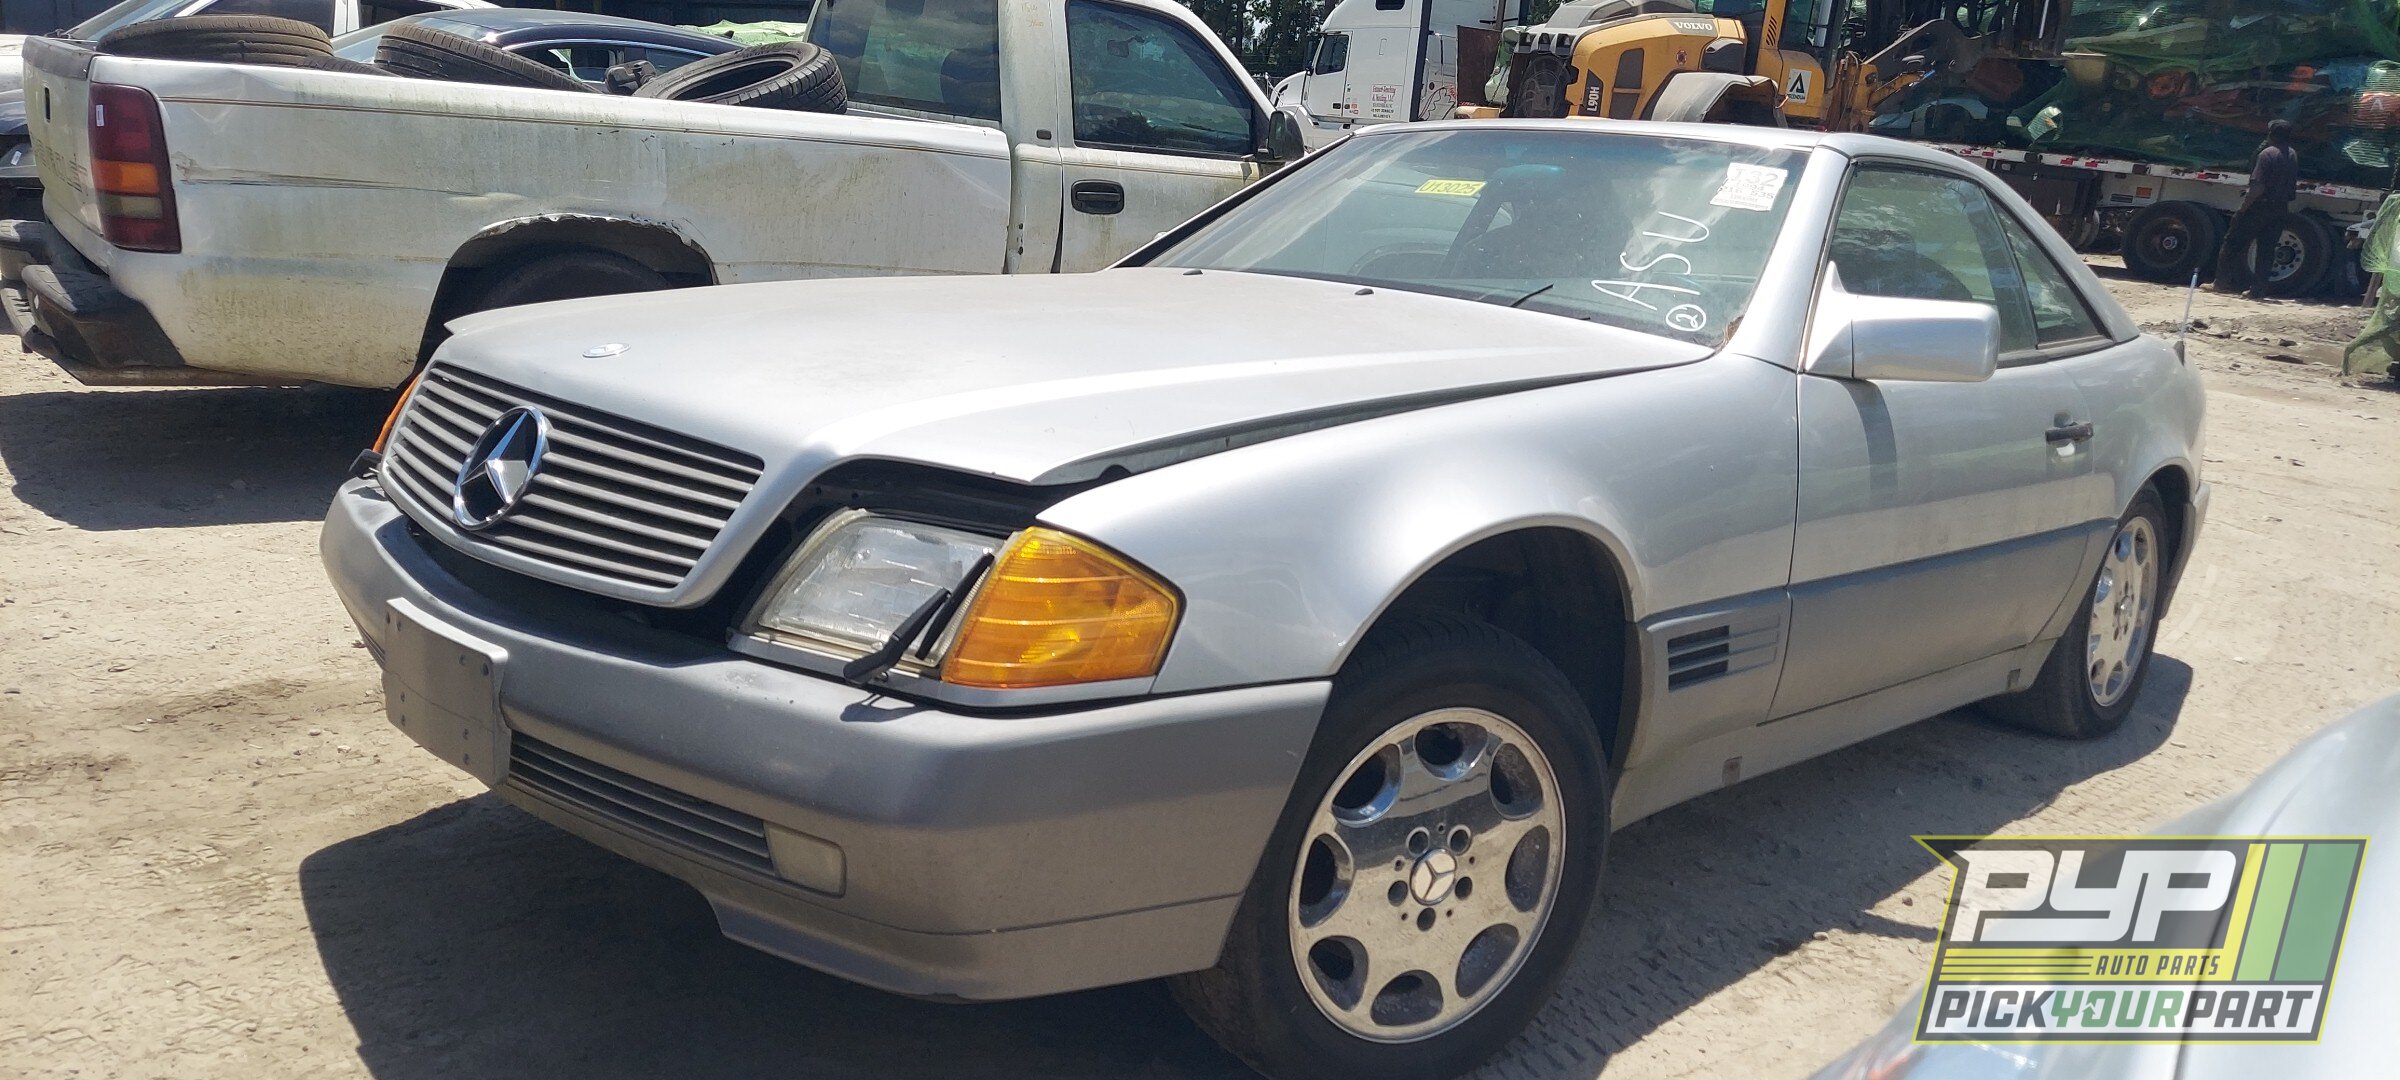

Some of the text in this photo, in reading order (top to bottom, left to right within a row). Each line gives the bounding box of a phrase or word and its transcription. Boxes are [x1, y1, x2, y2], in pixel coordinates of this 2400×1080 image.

[1673, 22, 1713, 31] VOLVO
[1587, 86, 1600, 112] L90H
[1591, 211, 1710, 311] ASU
